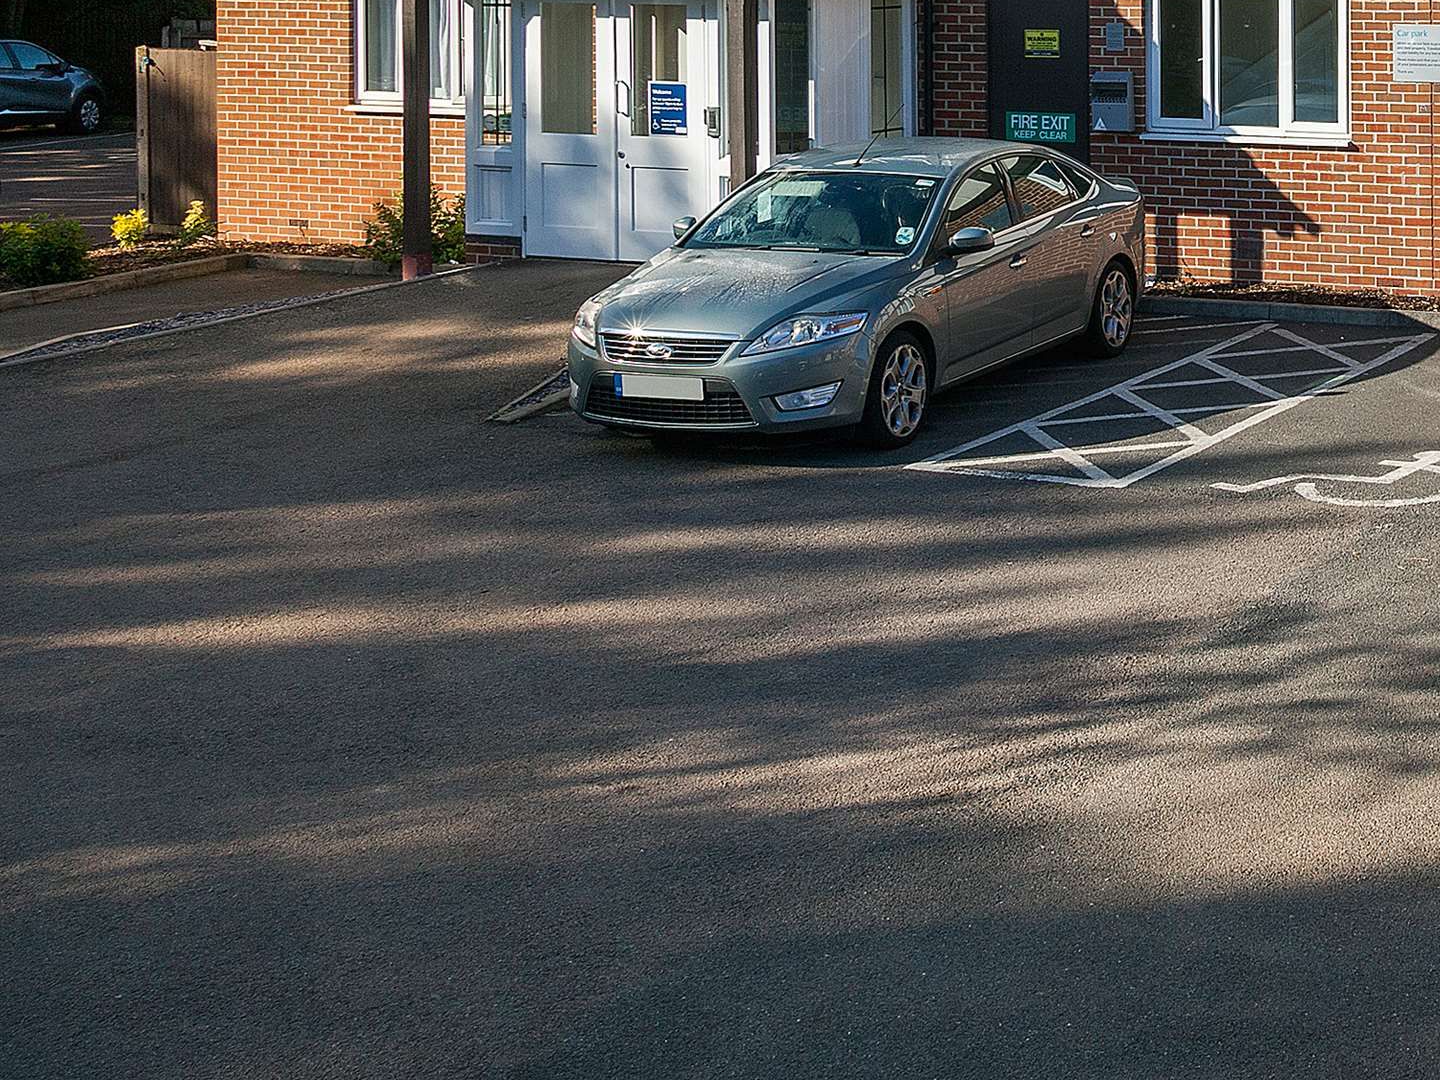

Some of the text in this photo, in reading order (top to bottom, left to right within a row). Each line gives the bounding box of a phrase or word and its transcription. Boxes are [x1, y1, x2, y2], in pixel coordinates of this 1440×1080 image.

[1396, 29, 1428, 38] Car park
[1011, 114, 1070, 130] FIRE EXIT
[1014, 130, 1067, 140] KEEP CLEAR
